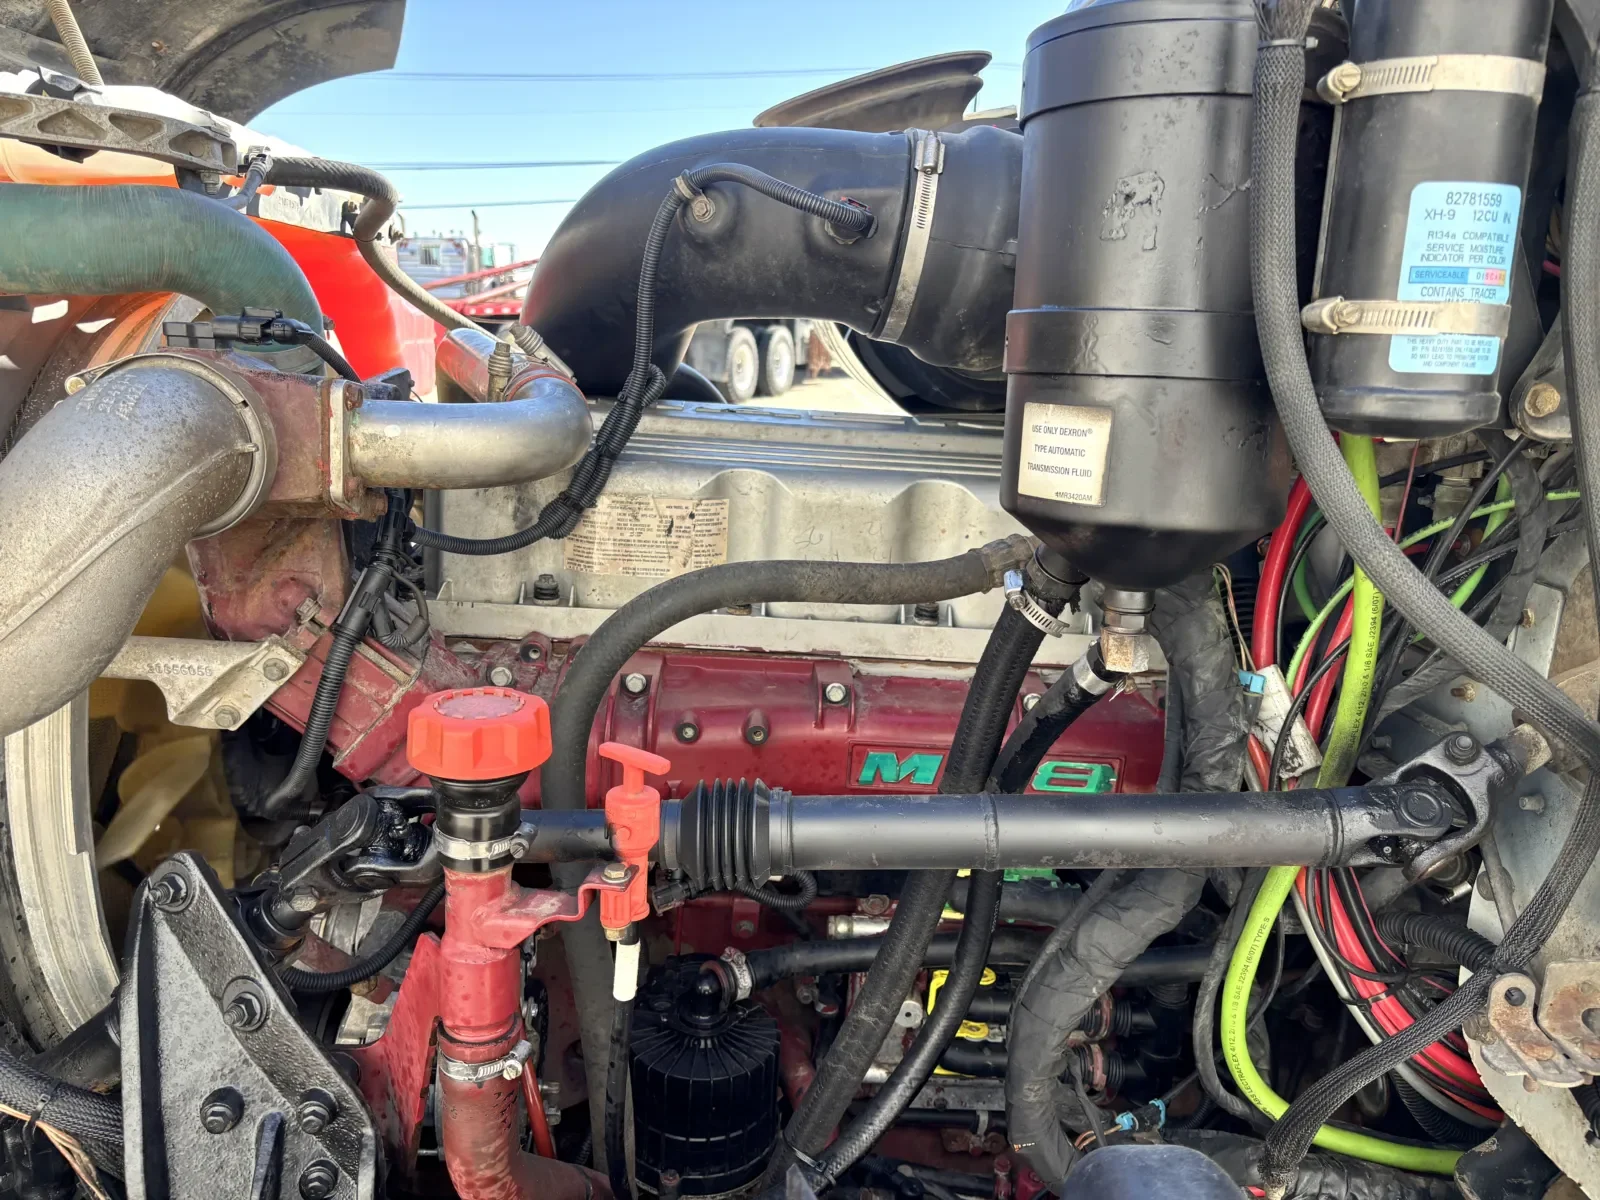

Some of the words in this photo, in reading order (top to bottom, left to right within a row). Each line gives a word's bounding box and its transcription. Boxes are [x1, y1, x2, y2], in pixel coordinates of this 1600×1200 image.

[1446, 192, 1502, 208] 82781559
[1424, 208, 1456, 220] XH-9
[1473, 210, 1498, 222] 12CU
[1428, 231, 1456, 240] R134a
[1462, 232, 1510, 243] COMPATIBLE
[1426, 244, 1464, 252] SERVICE
[1470, 244, 1505, 254] MOISTURE
[1420, 253, 1464, 263] INDICATOR
[1468, 254, 1483, 264] PER
[1487, 255, 1506, 265] COLOR
[1415, 270, 1465, 279] SERVICEABLE
[1420, 286, 1465, 297] CONTAINS
[1471, 288, 1496, 300] TRACER
[1032, 424, 1042, 433] USE
[1044, 426, 1058, 434] ONLY
[1034, 444, 1047, 453] TYPE
[1048, 446, 1086, 457] AUTOMATIC
[1028, 462, 1070, 475] TRANSMISSION
[1072, 468, 1092, 478] FLUID
[1372, 592, 1380, 614] (6/07)
[1368, 616, 1377, 640] J2394
[1365, 642, 1374, 658] SAE
[1364, 660, 1372, 672] 1/8
[1244, 944, 1260, 964] (6/07)
[1238, 964, 1249, 984] J2394
[1234, 984, 1242, 1000] SAE
[1232, 1053, 1253, 1094] LECTRAFLEX
